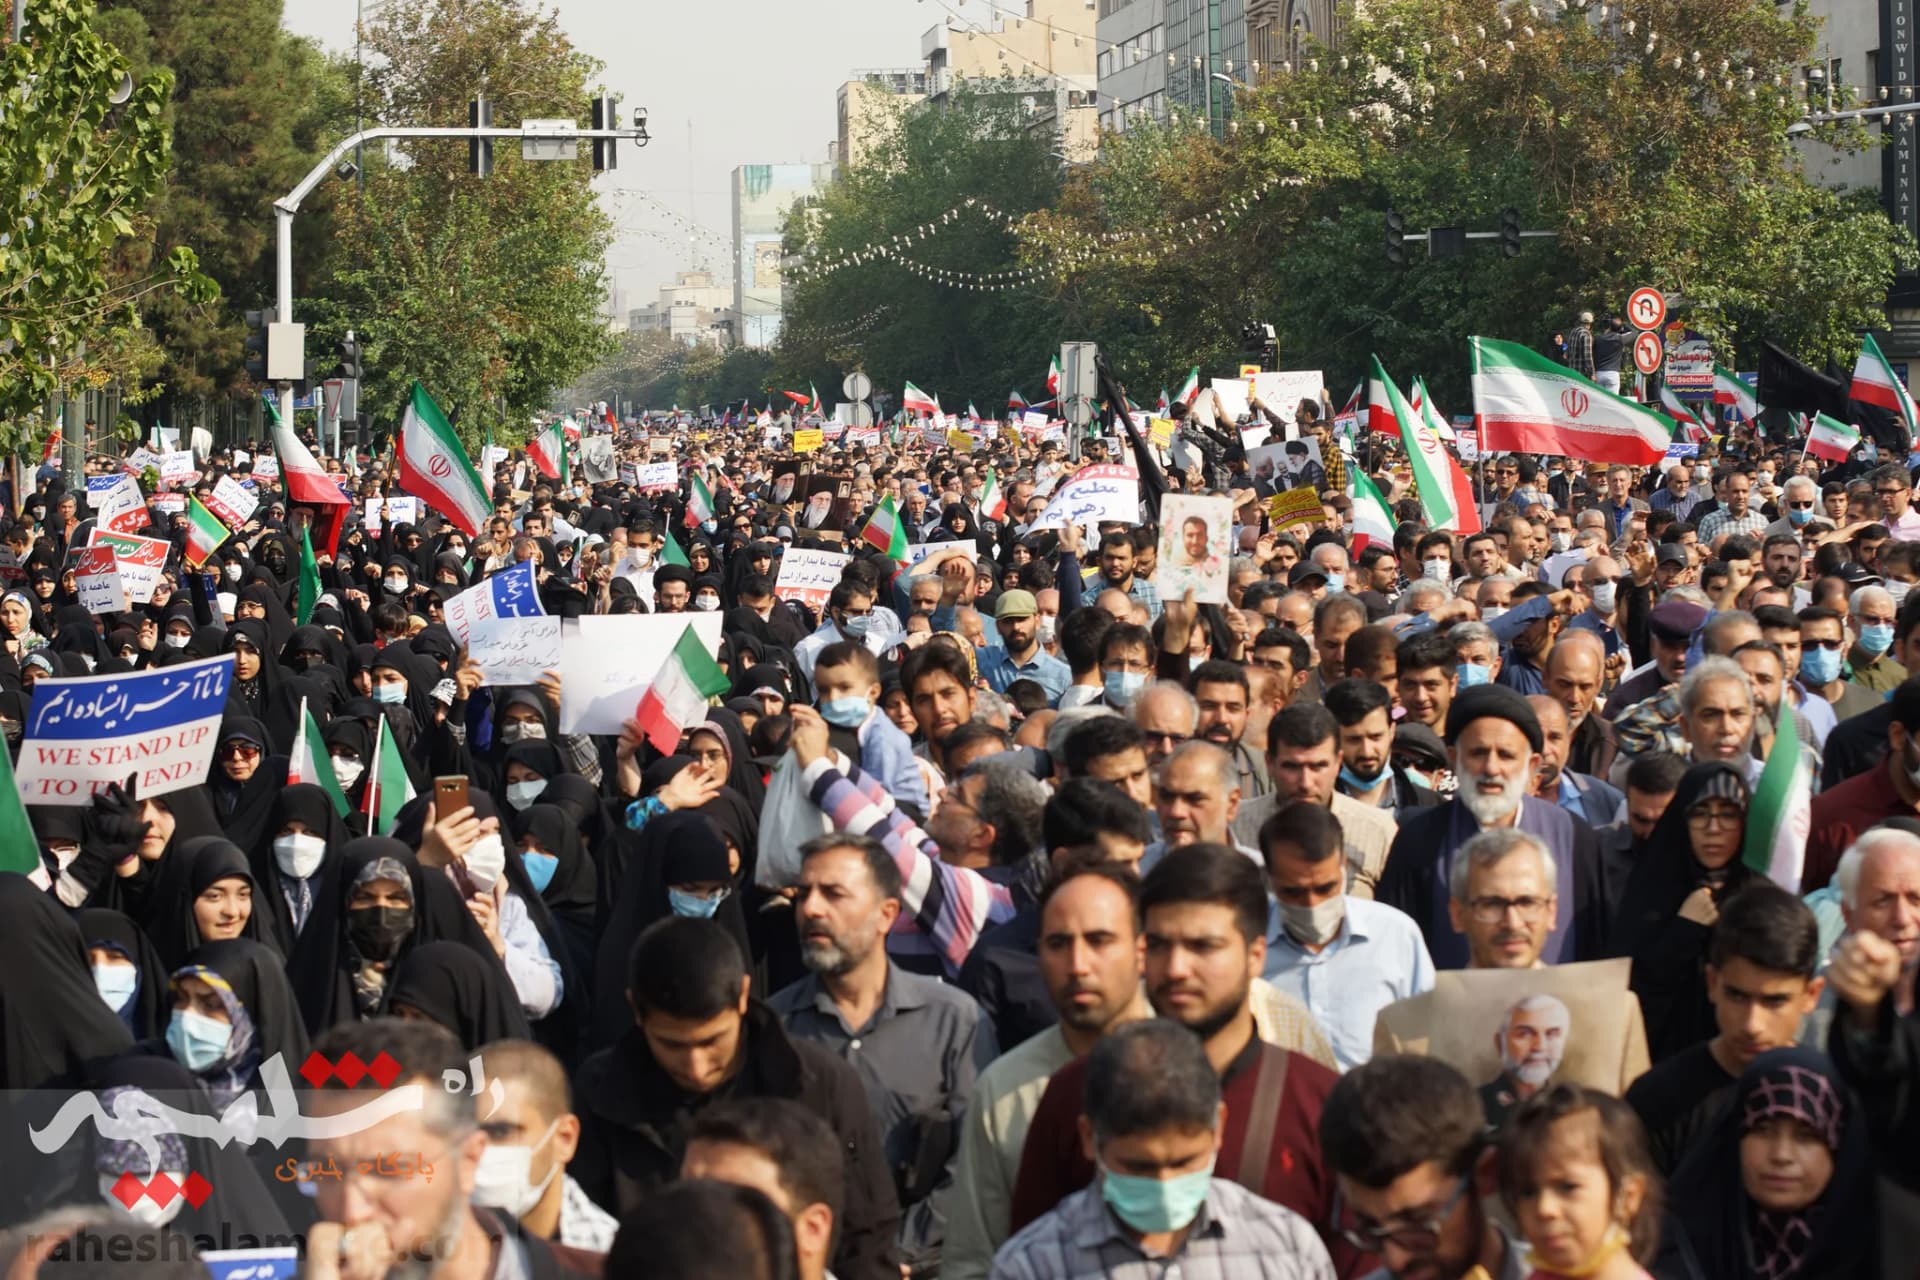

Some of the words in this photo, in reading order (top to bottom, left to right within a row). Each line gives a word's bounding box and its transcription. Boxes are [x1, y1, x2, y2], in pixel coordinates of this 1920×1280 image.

[34, 688, 74, 737] ایم
[73, 683, 129, 730] ایستاده
[37, 746, 82, 766] WE
[88, 736, 172, 766] STAND
[179, 725, 210, 749] UP
[38, 778, 78, 796] TO
[143, 761, 193, 788] END
